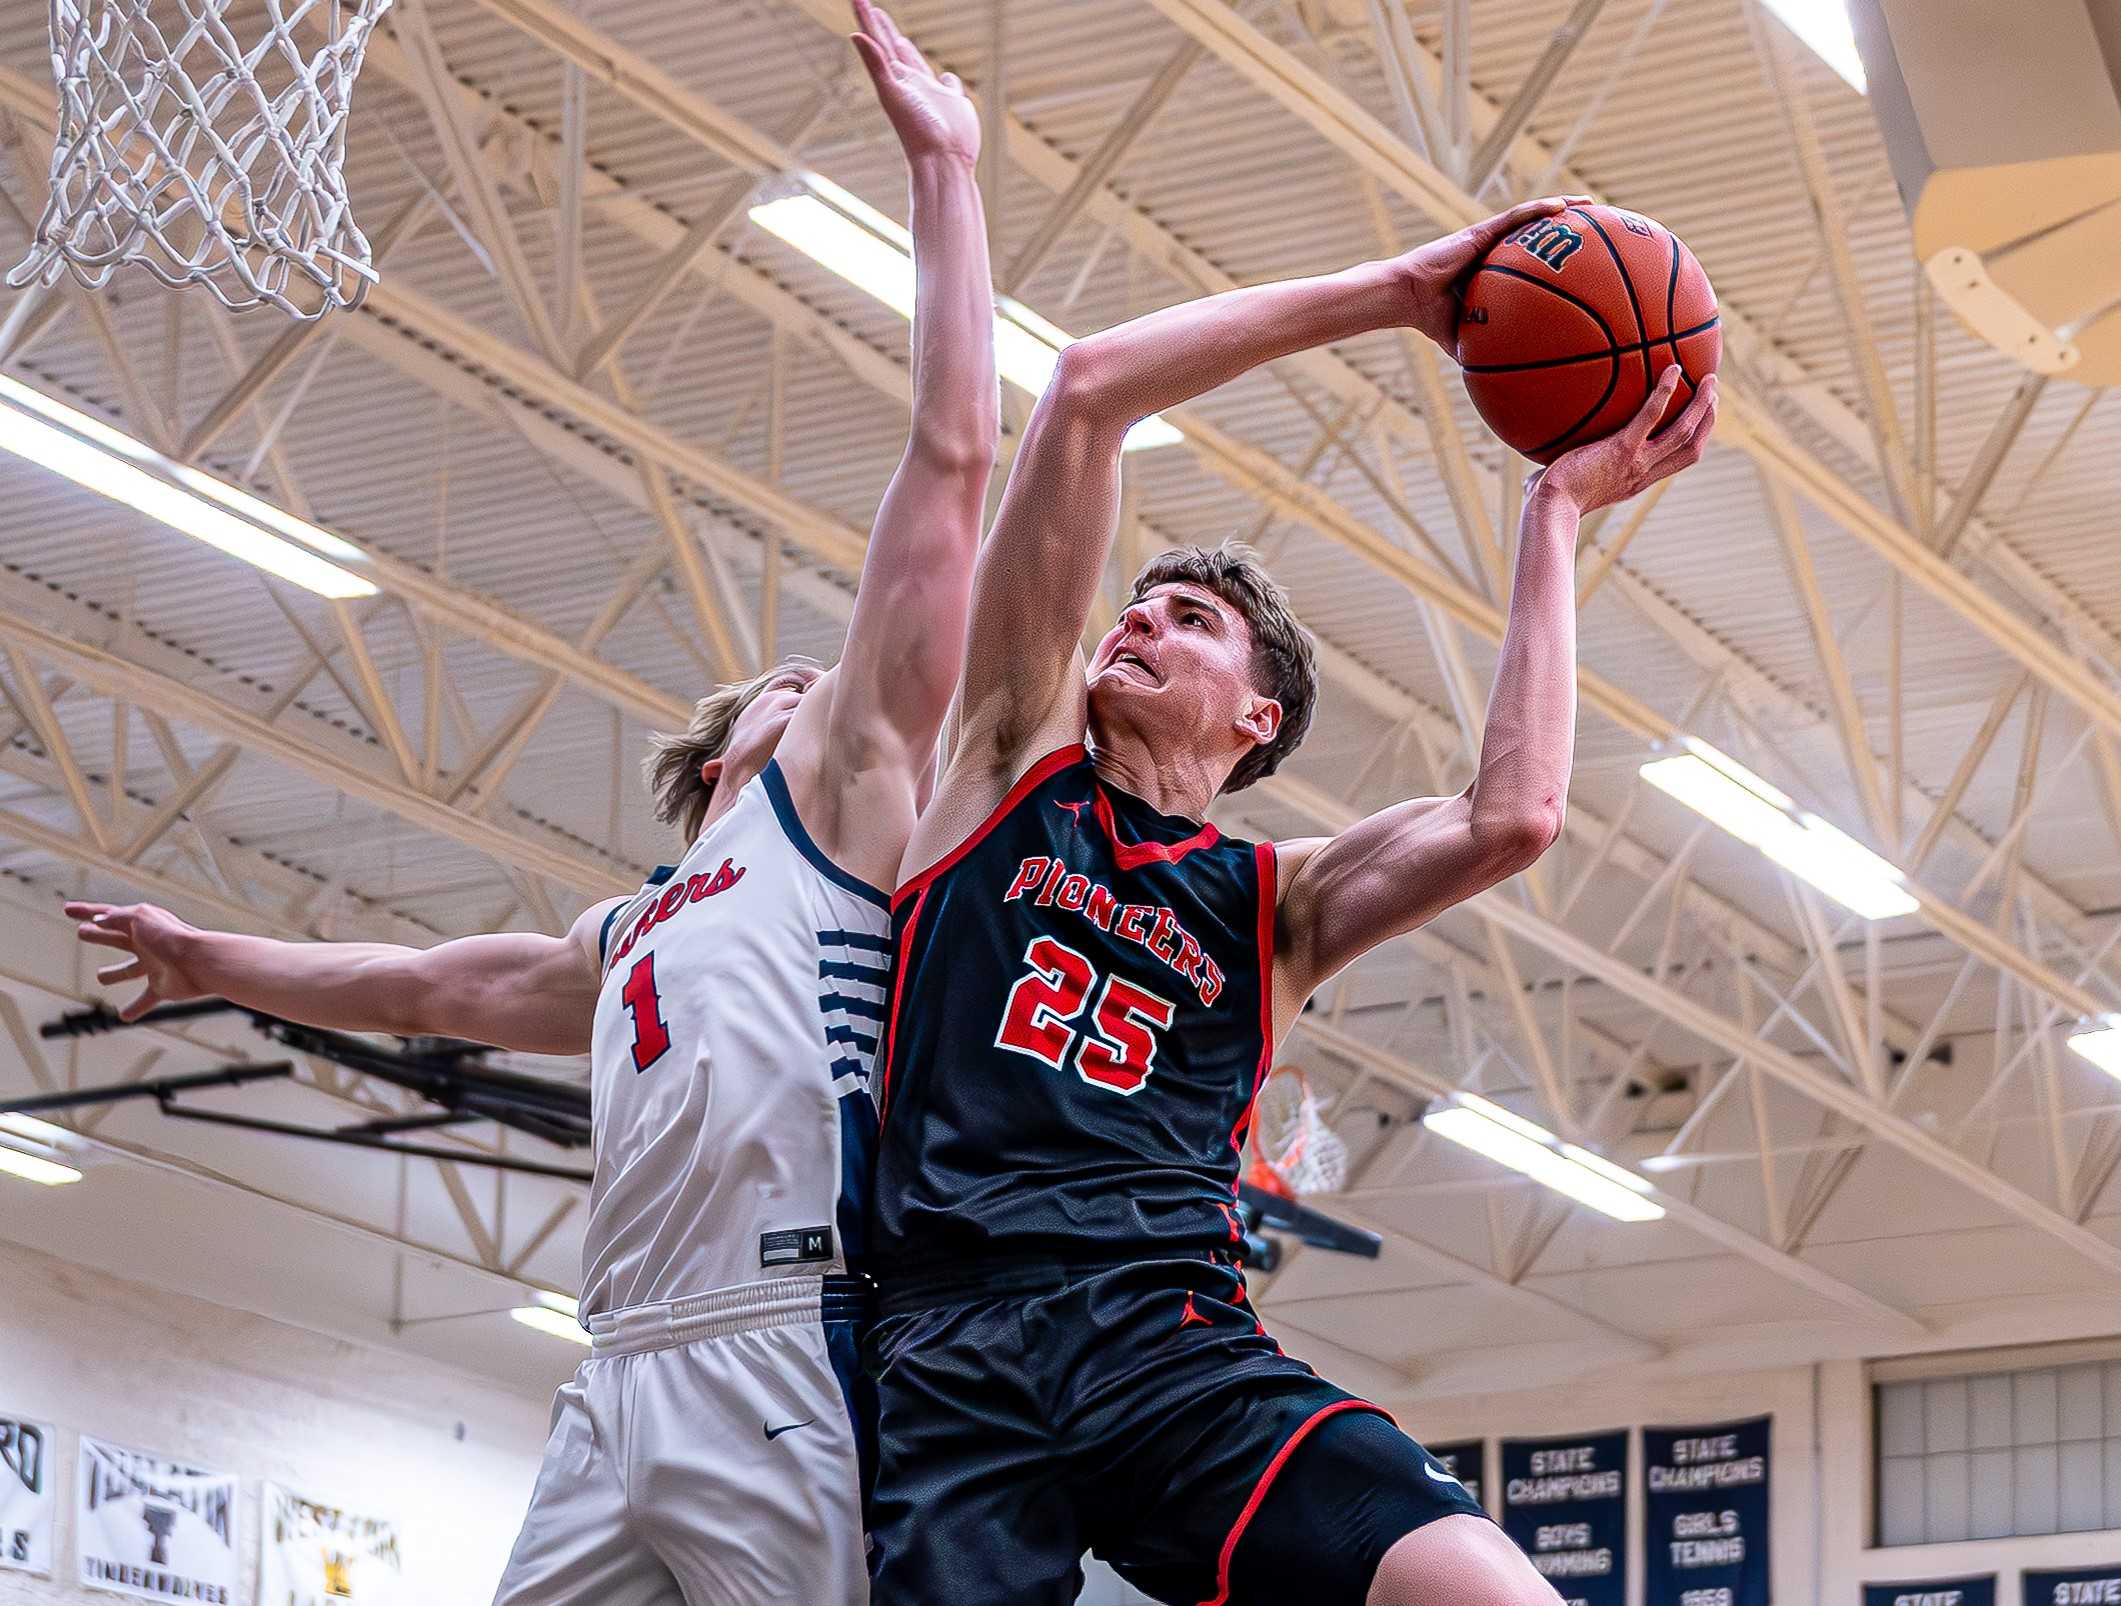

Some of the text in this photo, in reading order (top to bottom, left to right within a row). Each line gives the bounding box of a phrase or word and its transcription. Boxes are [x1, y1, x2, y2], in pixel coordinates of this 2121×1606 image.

[1003, 855, 1227, 1008] PIONEERS
[621, 949, 672, 1075] 1
[993, 935, 1177, 1097] 25
[808, 1236, 824, 1252] M
[1531, 1448, 1596, 1475] STATE
[1673, 1434, 1737, 1463] STATE
[1507, 1470, 1622, 1506] CHAMPIONS
[1648, 1455, 1765, 1493] CHAMPIONS
[1534, 1522, 1593, 1552] BOYS
[1673, 1510, 1739, 1537] GIRLS
[1669, 1537, 1745, 1567] TENNIS
